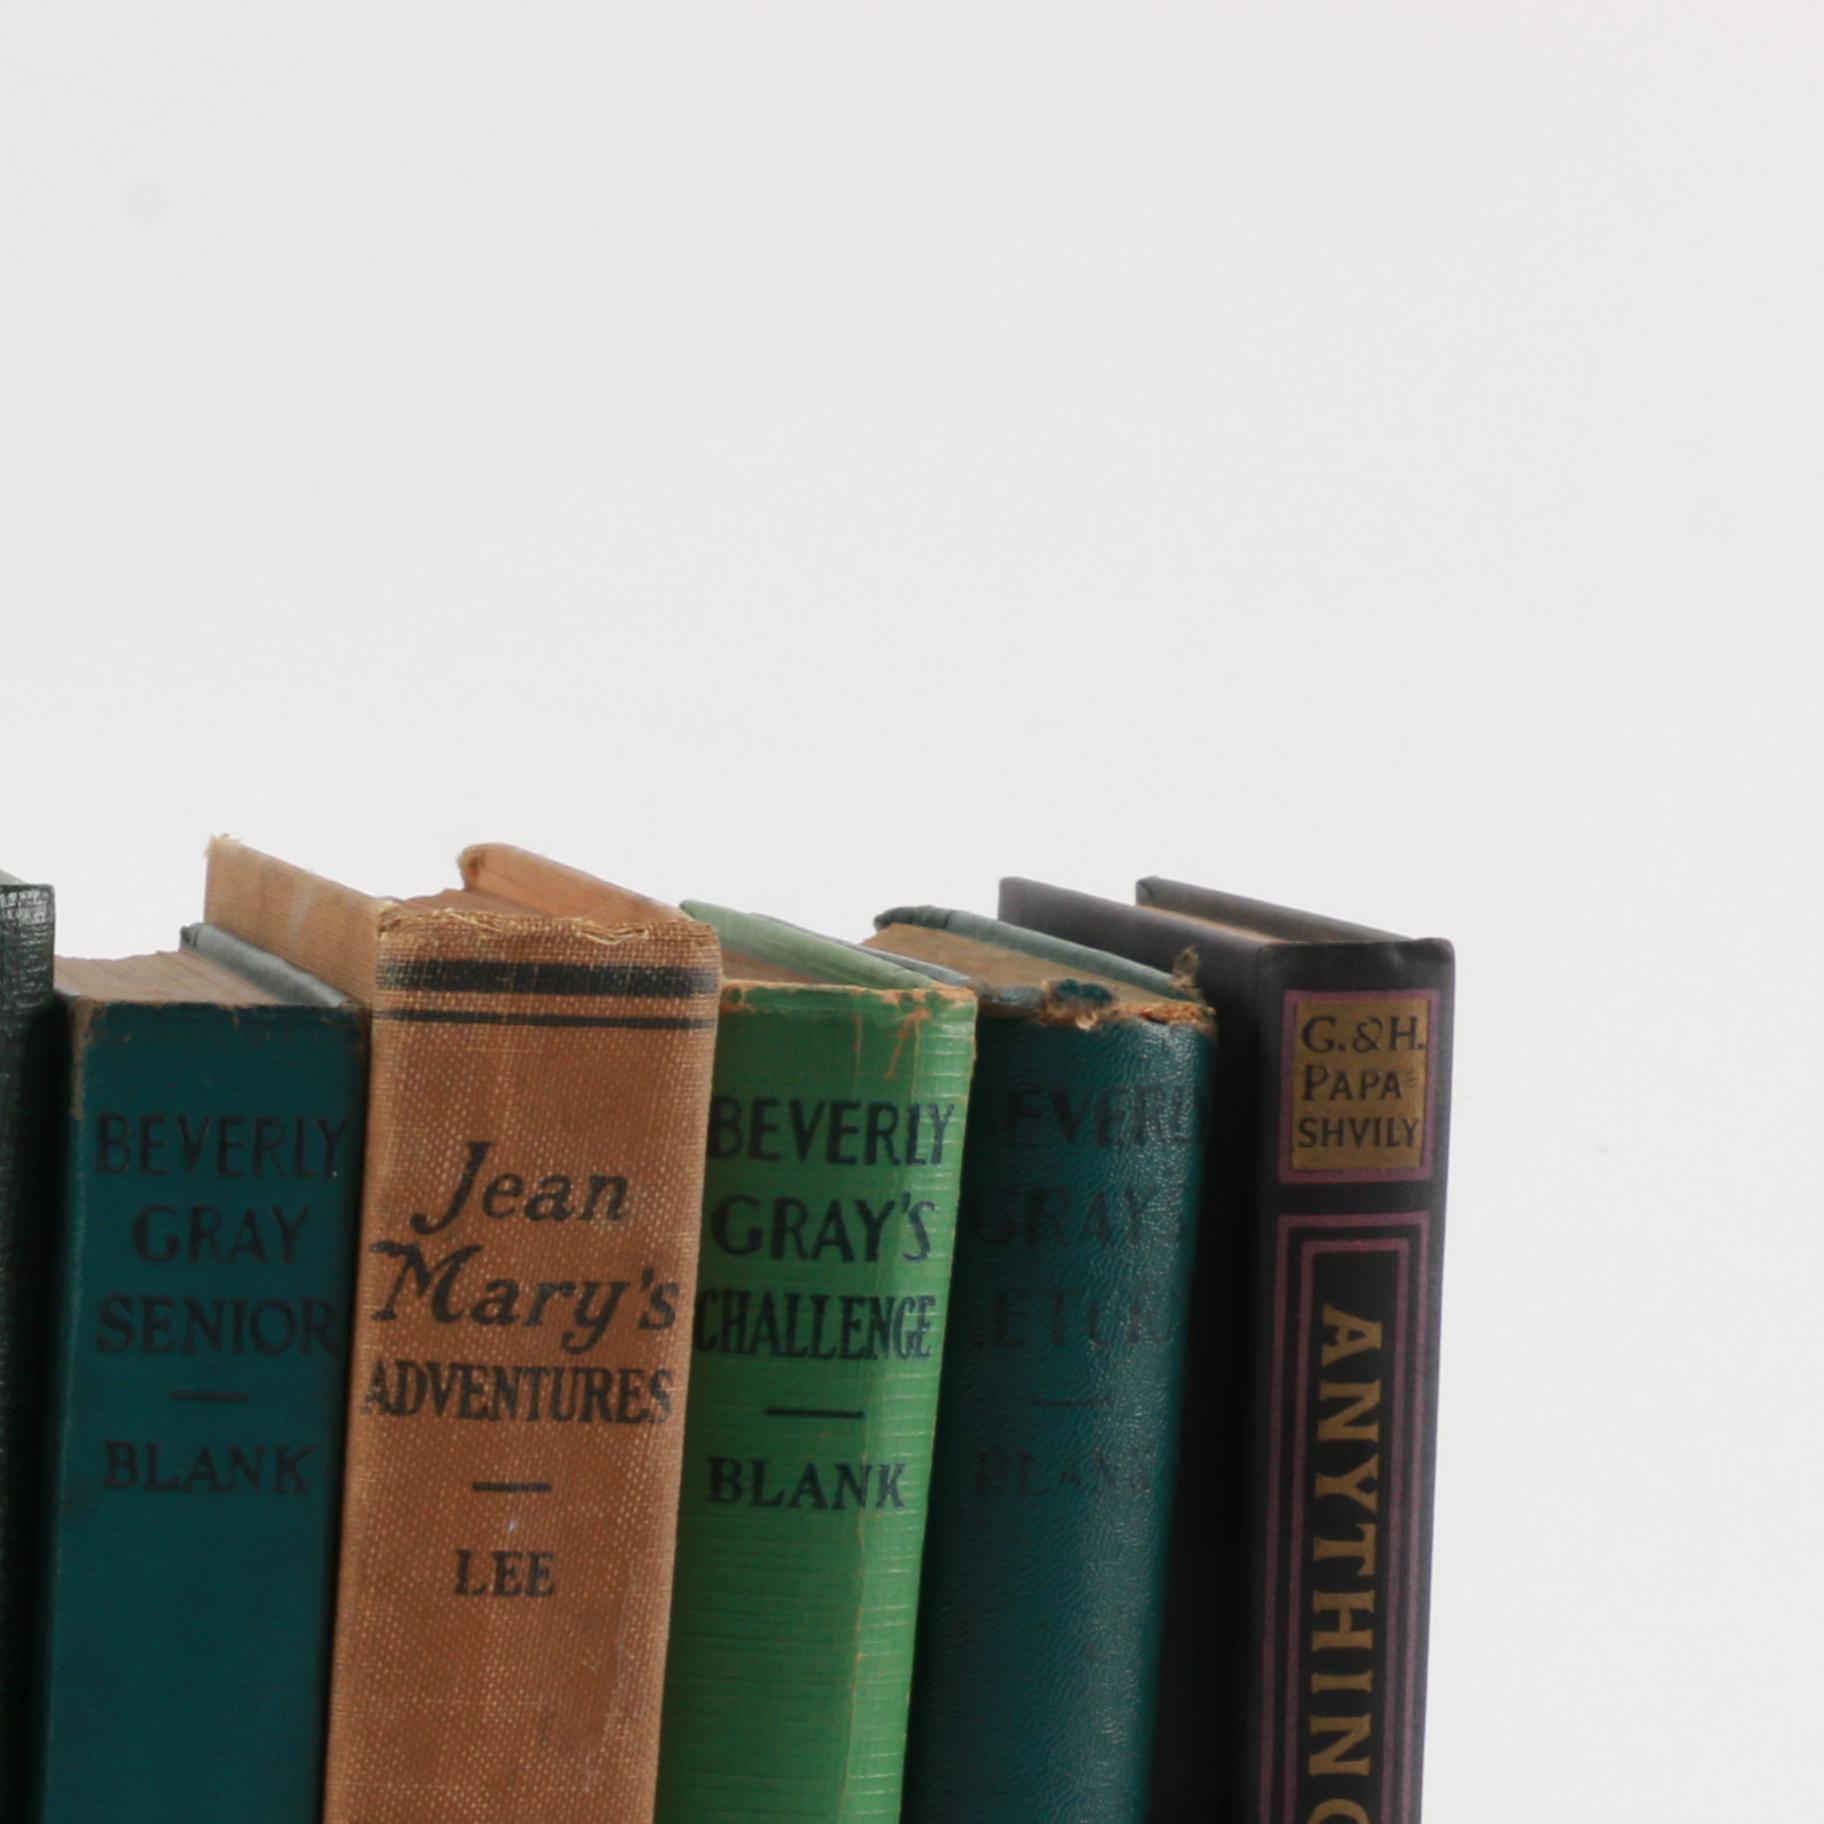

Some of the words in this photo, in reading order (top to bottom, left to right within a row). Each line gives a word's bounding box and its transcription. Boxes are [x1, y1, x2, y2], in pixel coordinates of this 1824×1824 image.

[92, 1112, 350, 1178] BEVERLY
[708, 1097, 954, 1166] BEVERLY
[1298, 1117, 1419, 1148] SHVILY
[410, 1141, 630, 1234] Jean
[131, 1204, 311, 1265] GRAY
[710, 1192, 936, 1262] GRAY'S
[94, 1293, 340, 1356] SENIOR
[370, 1240, 679, 1354] Mary's
[694, 1289, 936, 1361] CHALLENGE
[364, 1358, 675, 1425] ADVENTURES
[102, 1440, 318, 1493] BLANK
[708, 1456, 905, 1510] BLANK
[454, 1549, 556, 1598] LEE
